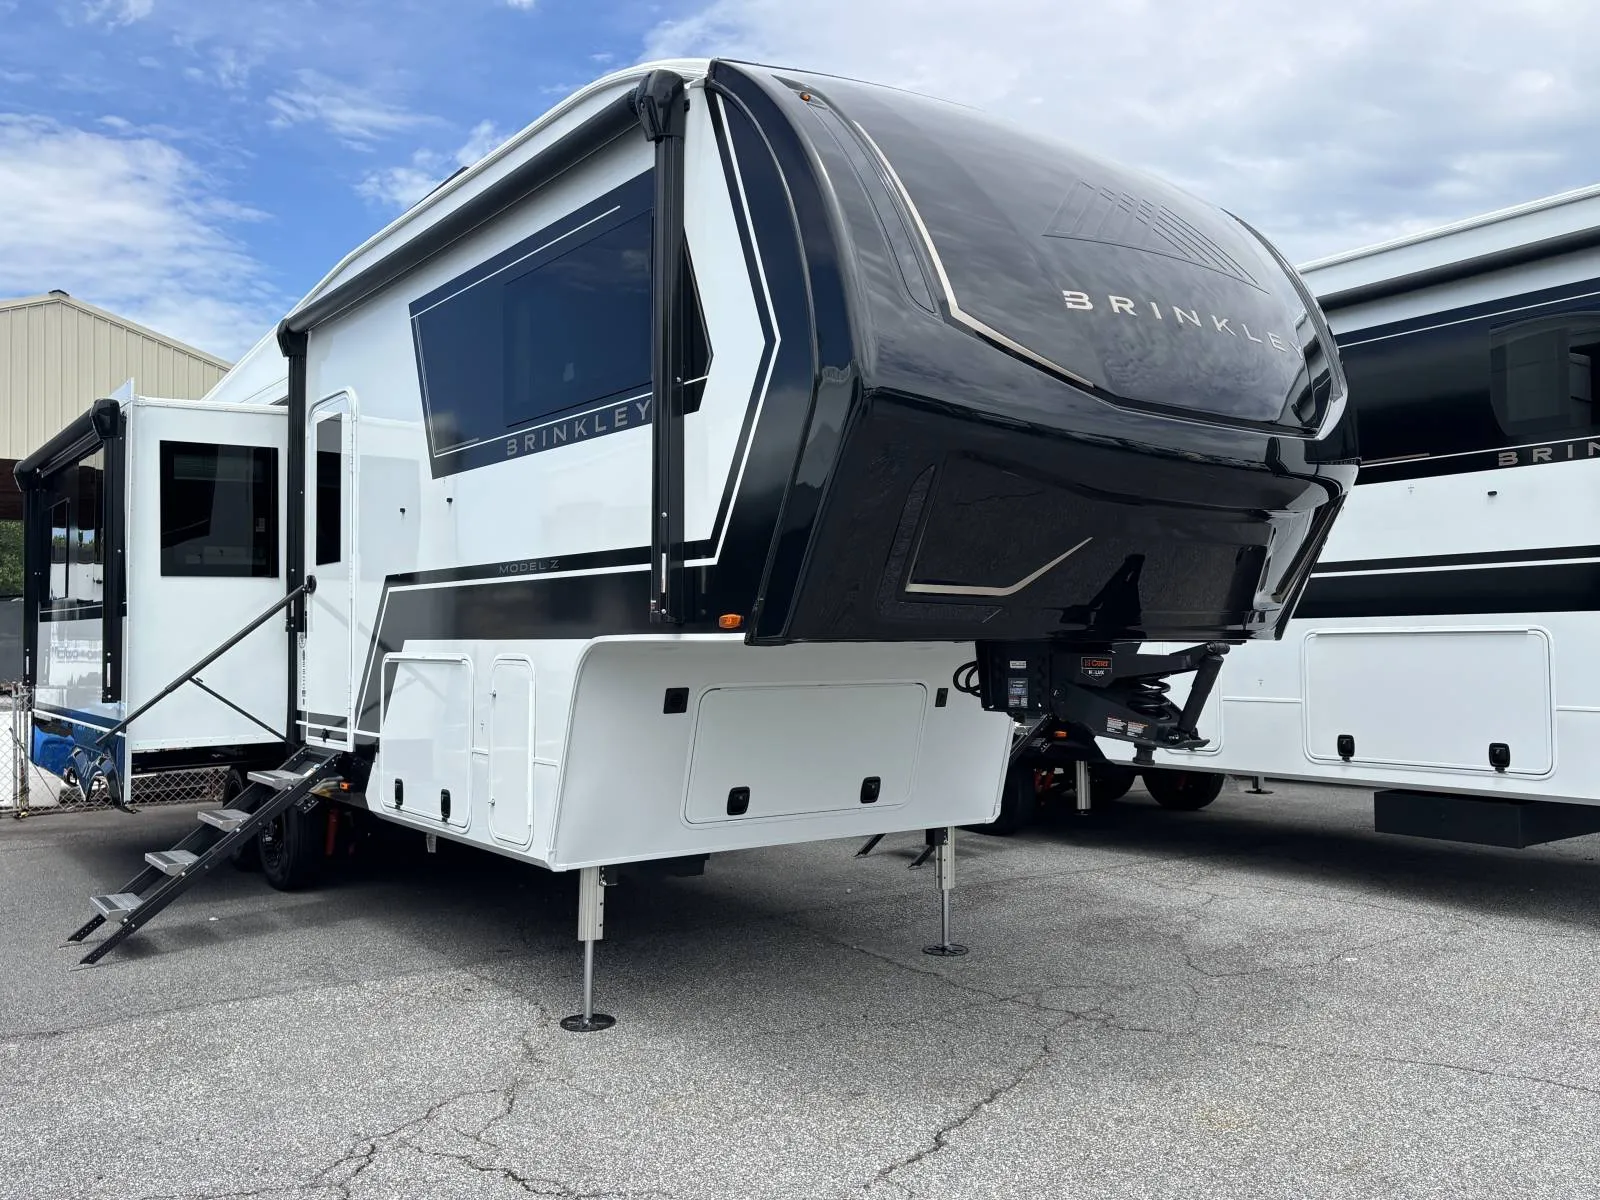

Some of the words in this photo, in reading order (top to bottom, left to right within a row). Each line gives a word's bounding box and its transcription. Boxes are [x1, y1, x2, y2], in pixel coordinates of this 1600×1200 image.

[1062, 290, 1304, 360] BRINKLEY
[506, 399, 652, 456] BRINKLEY
[499, 561, 546, 574] MODEL
[550, 559, 560, 569] Z
